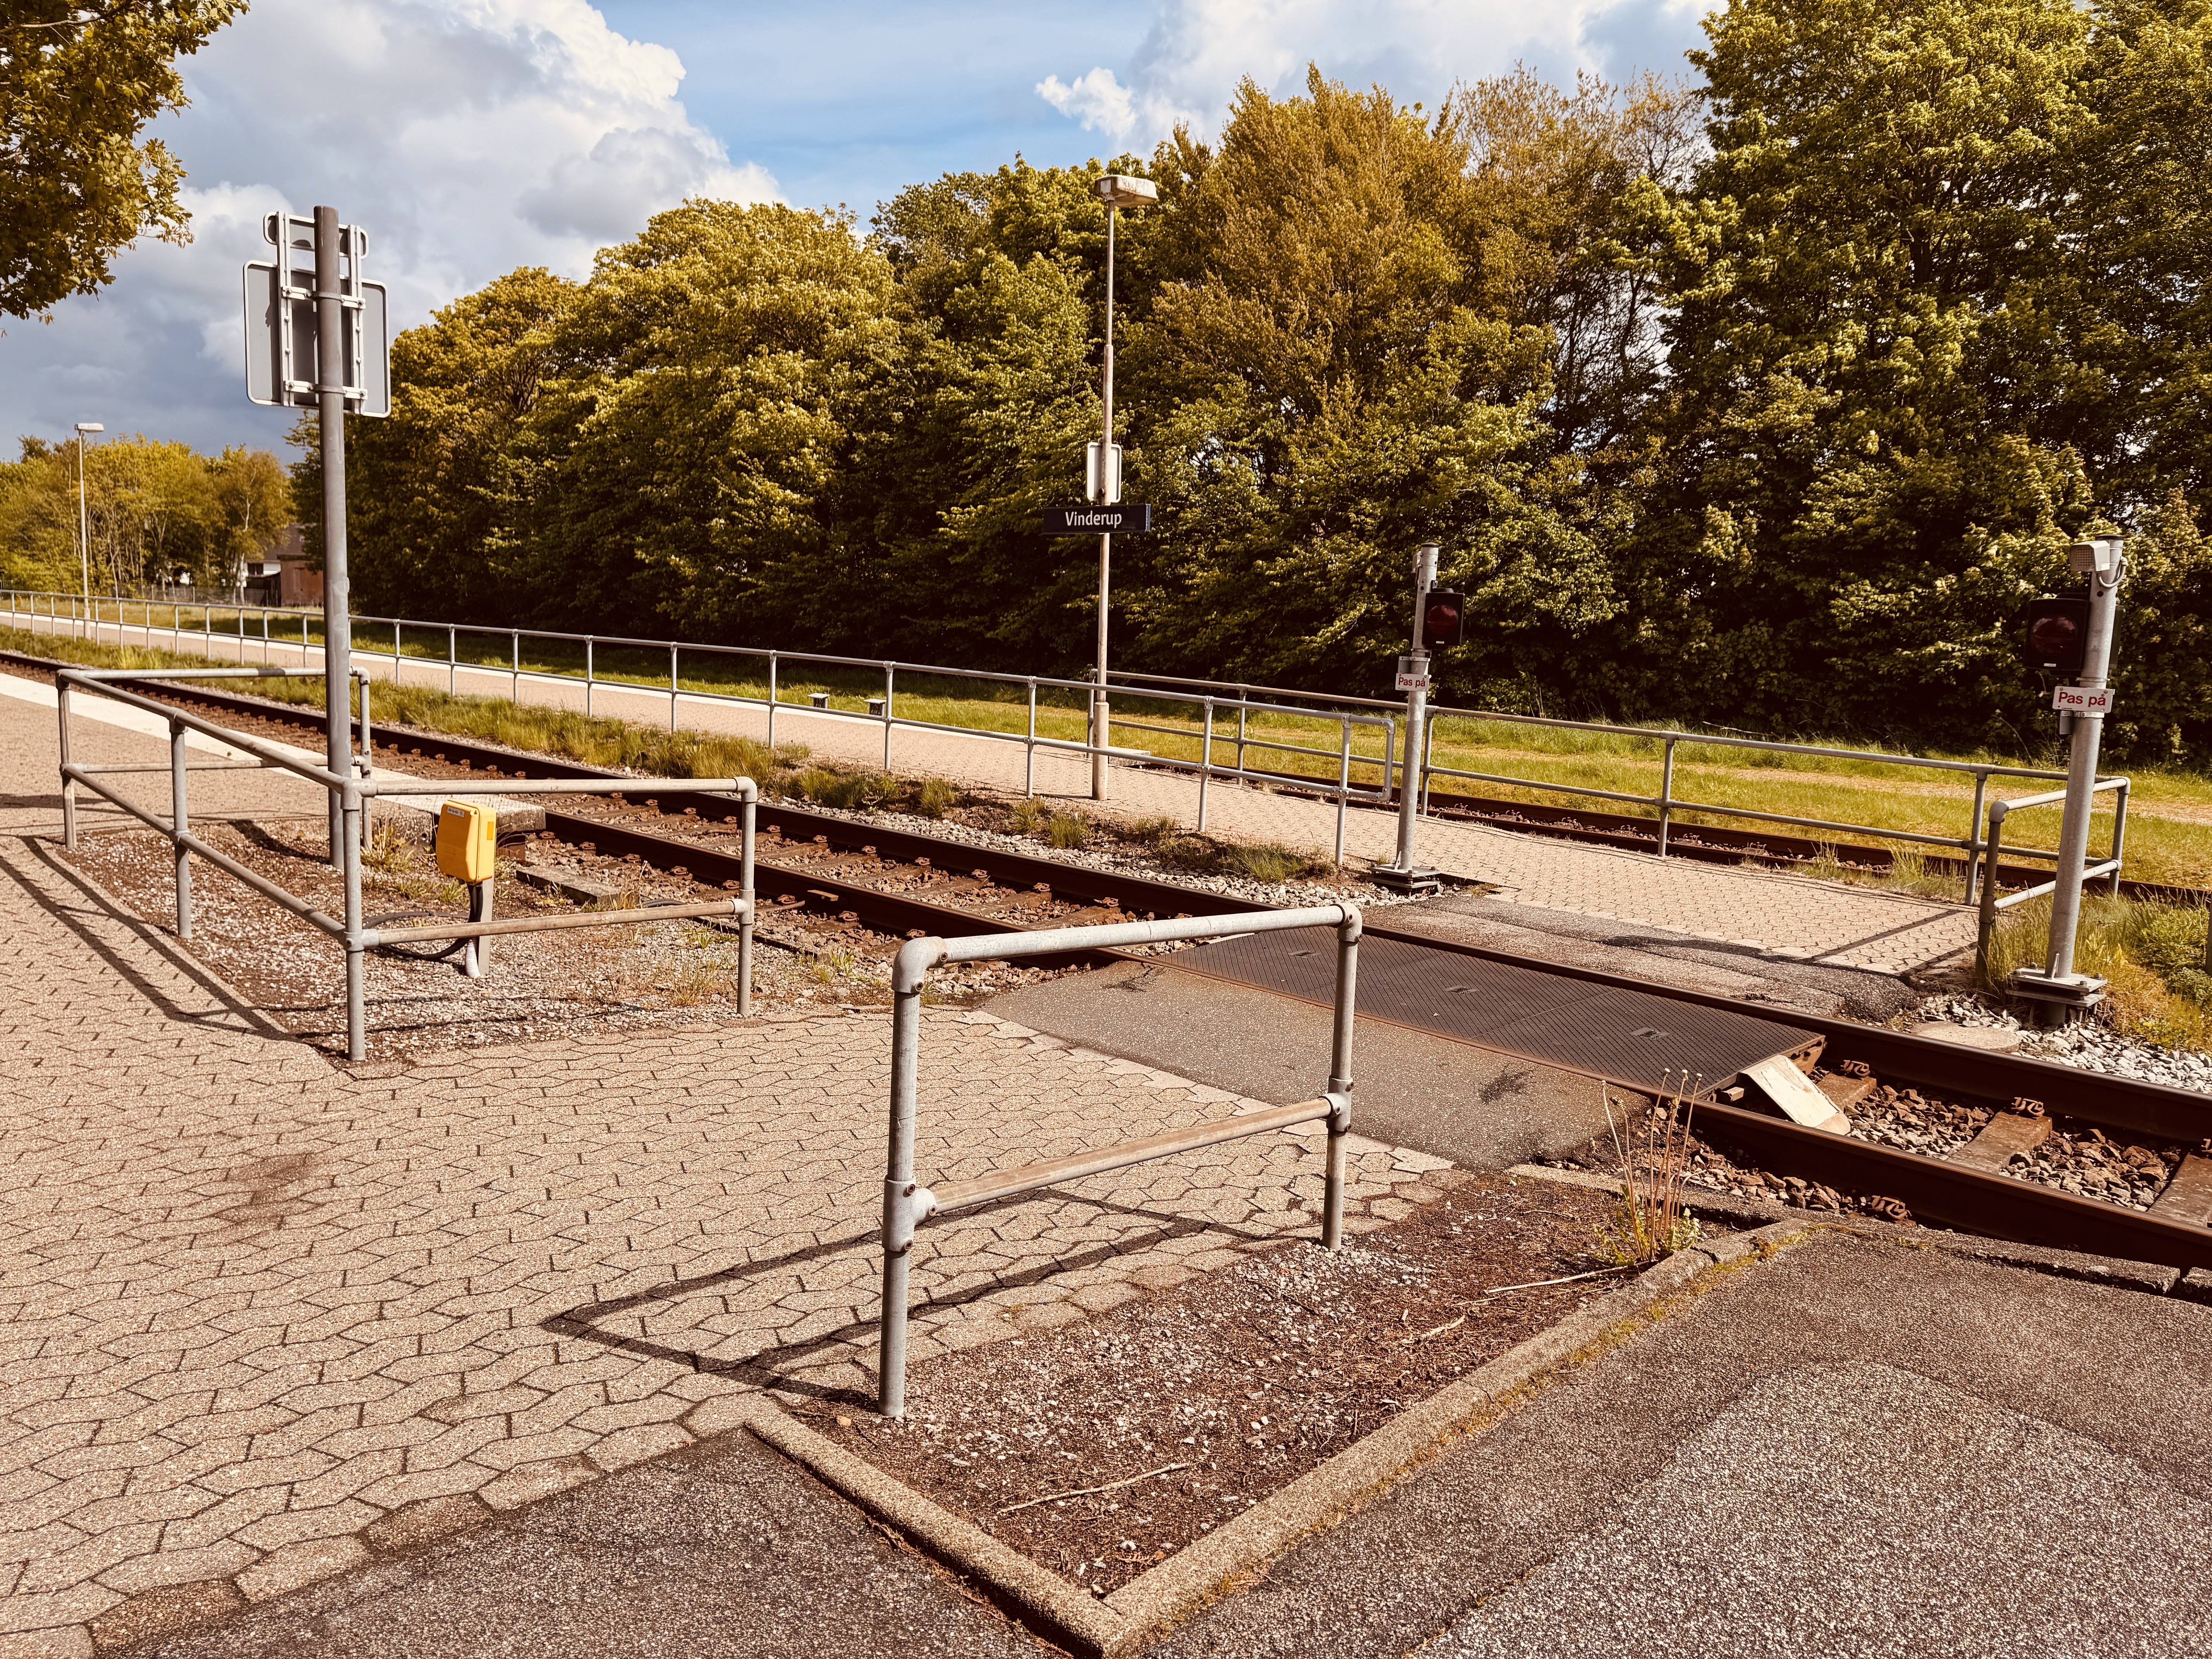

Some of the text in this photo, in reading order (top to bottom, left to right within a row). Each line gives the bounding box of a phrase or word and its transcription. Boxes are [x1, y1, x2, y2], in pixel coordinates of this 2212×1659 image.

[1065, 510, 1122, 529] Vinderup
[1398, 677, 1425, 688] Pas på
[2059, 692, 2106, 707] Pas på
